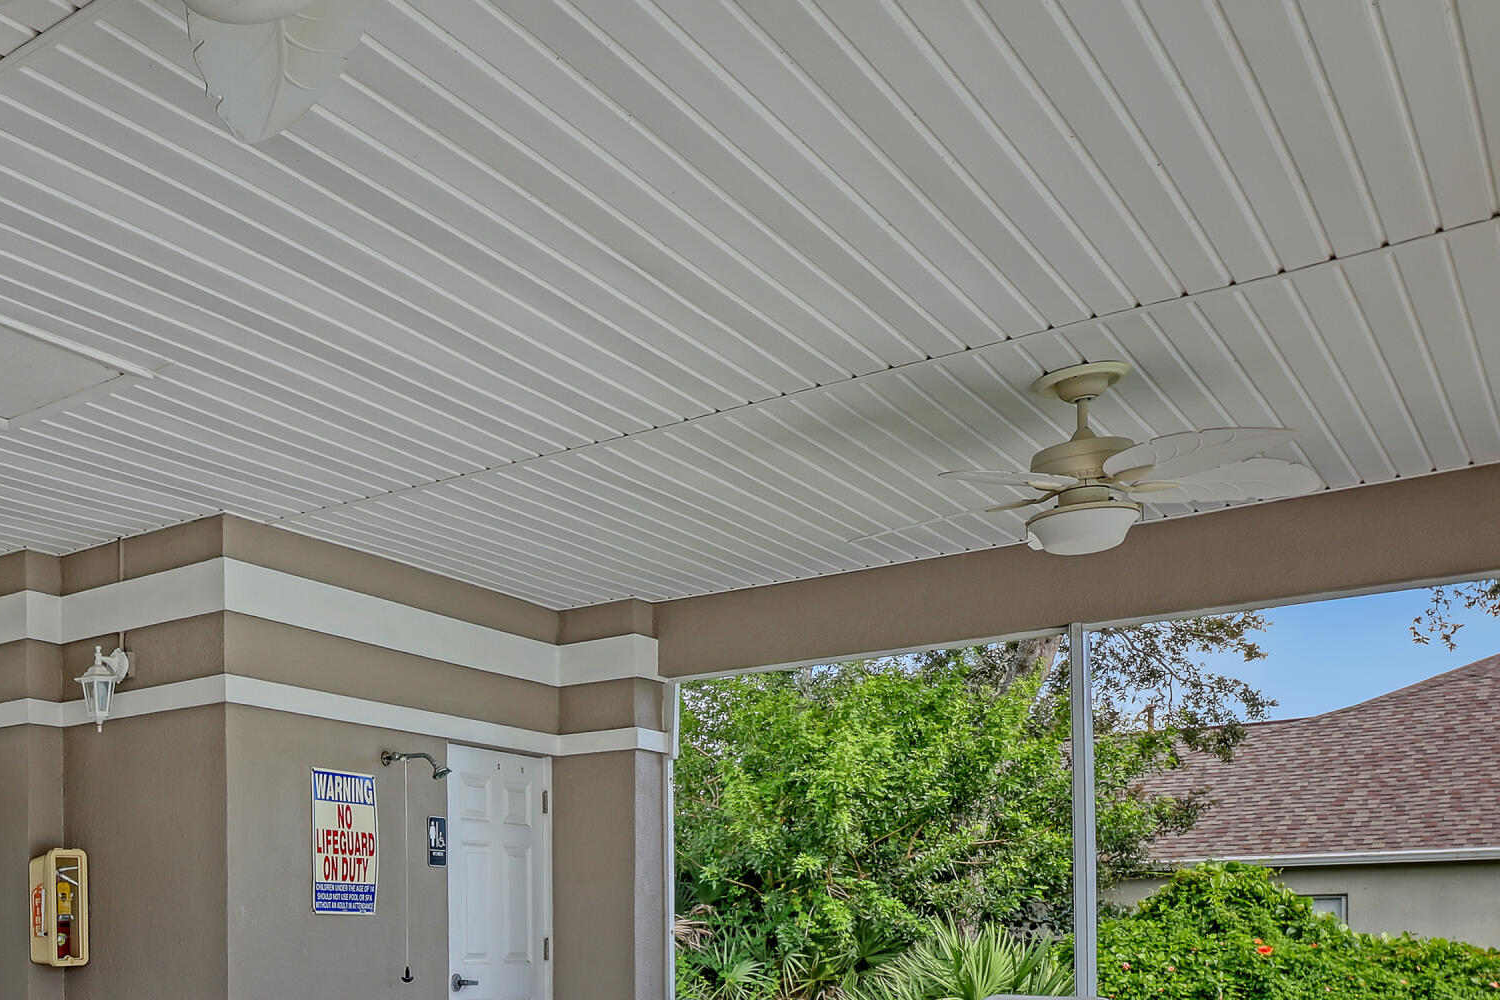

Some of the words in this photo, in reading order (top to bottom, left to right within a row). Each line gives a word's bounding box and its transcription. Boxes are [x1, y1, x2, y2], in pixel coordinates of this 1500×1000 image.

[315, 773, 373, 804] WARNING
[338, 804, 352, 829] NO
[317, 829, 374, 856] LIFEGUARD
[324, 856, 338, 881] ON
[342, 858, 368, 882] DUTY
